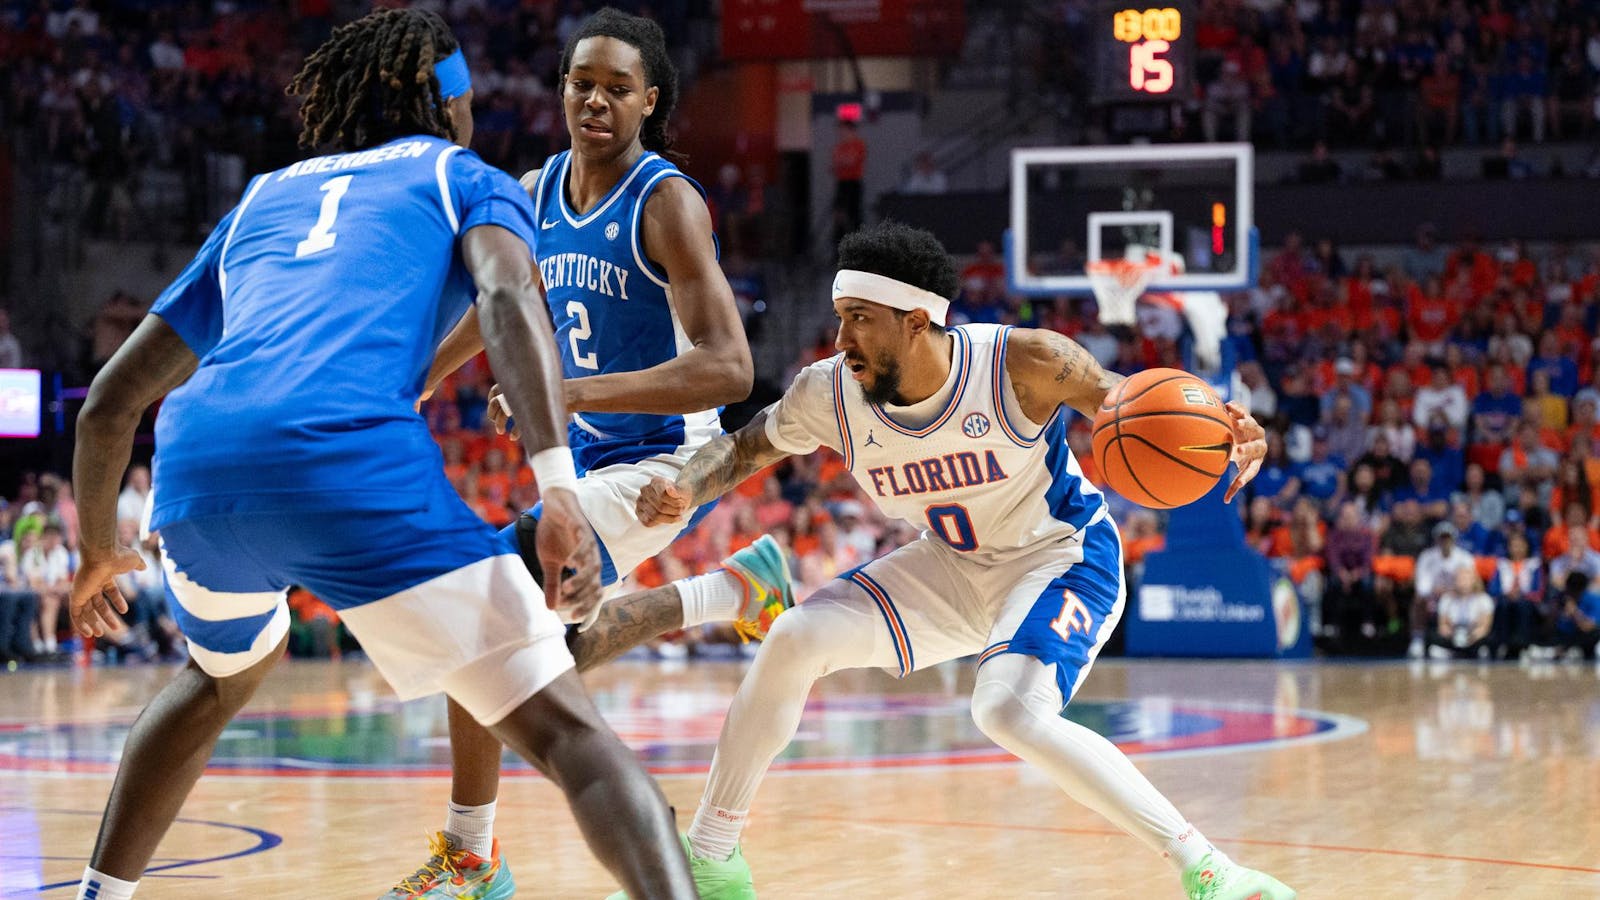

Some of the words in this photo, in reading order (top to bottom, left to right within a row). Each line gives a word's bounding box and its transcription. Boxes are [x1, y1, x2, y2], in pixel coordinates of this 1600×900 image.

[1129, 39, 1175, 94] 15
[277, 141, 432, 182] ABERDEEN
[295, 174, 354, 259] 1
[566, 300, 599, 370] 2
[962, 412, 990, 438] SEC
[867, 449, 1009, 498] FLORIDA
[924, 502, 979, 552] 0
[1049, 588, 1094, 643] F
